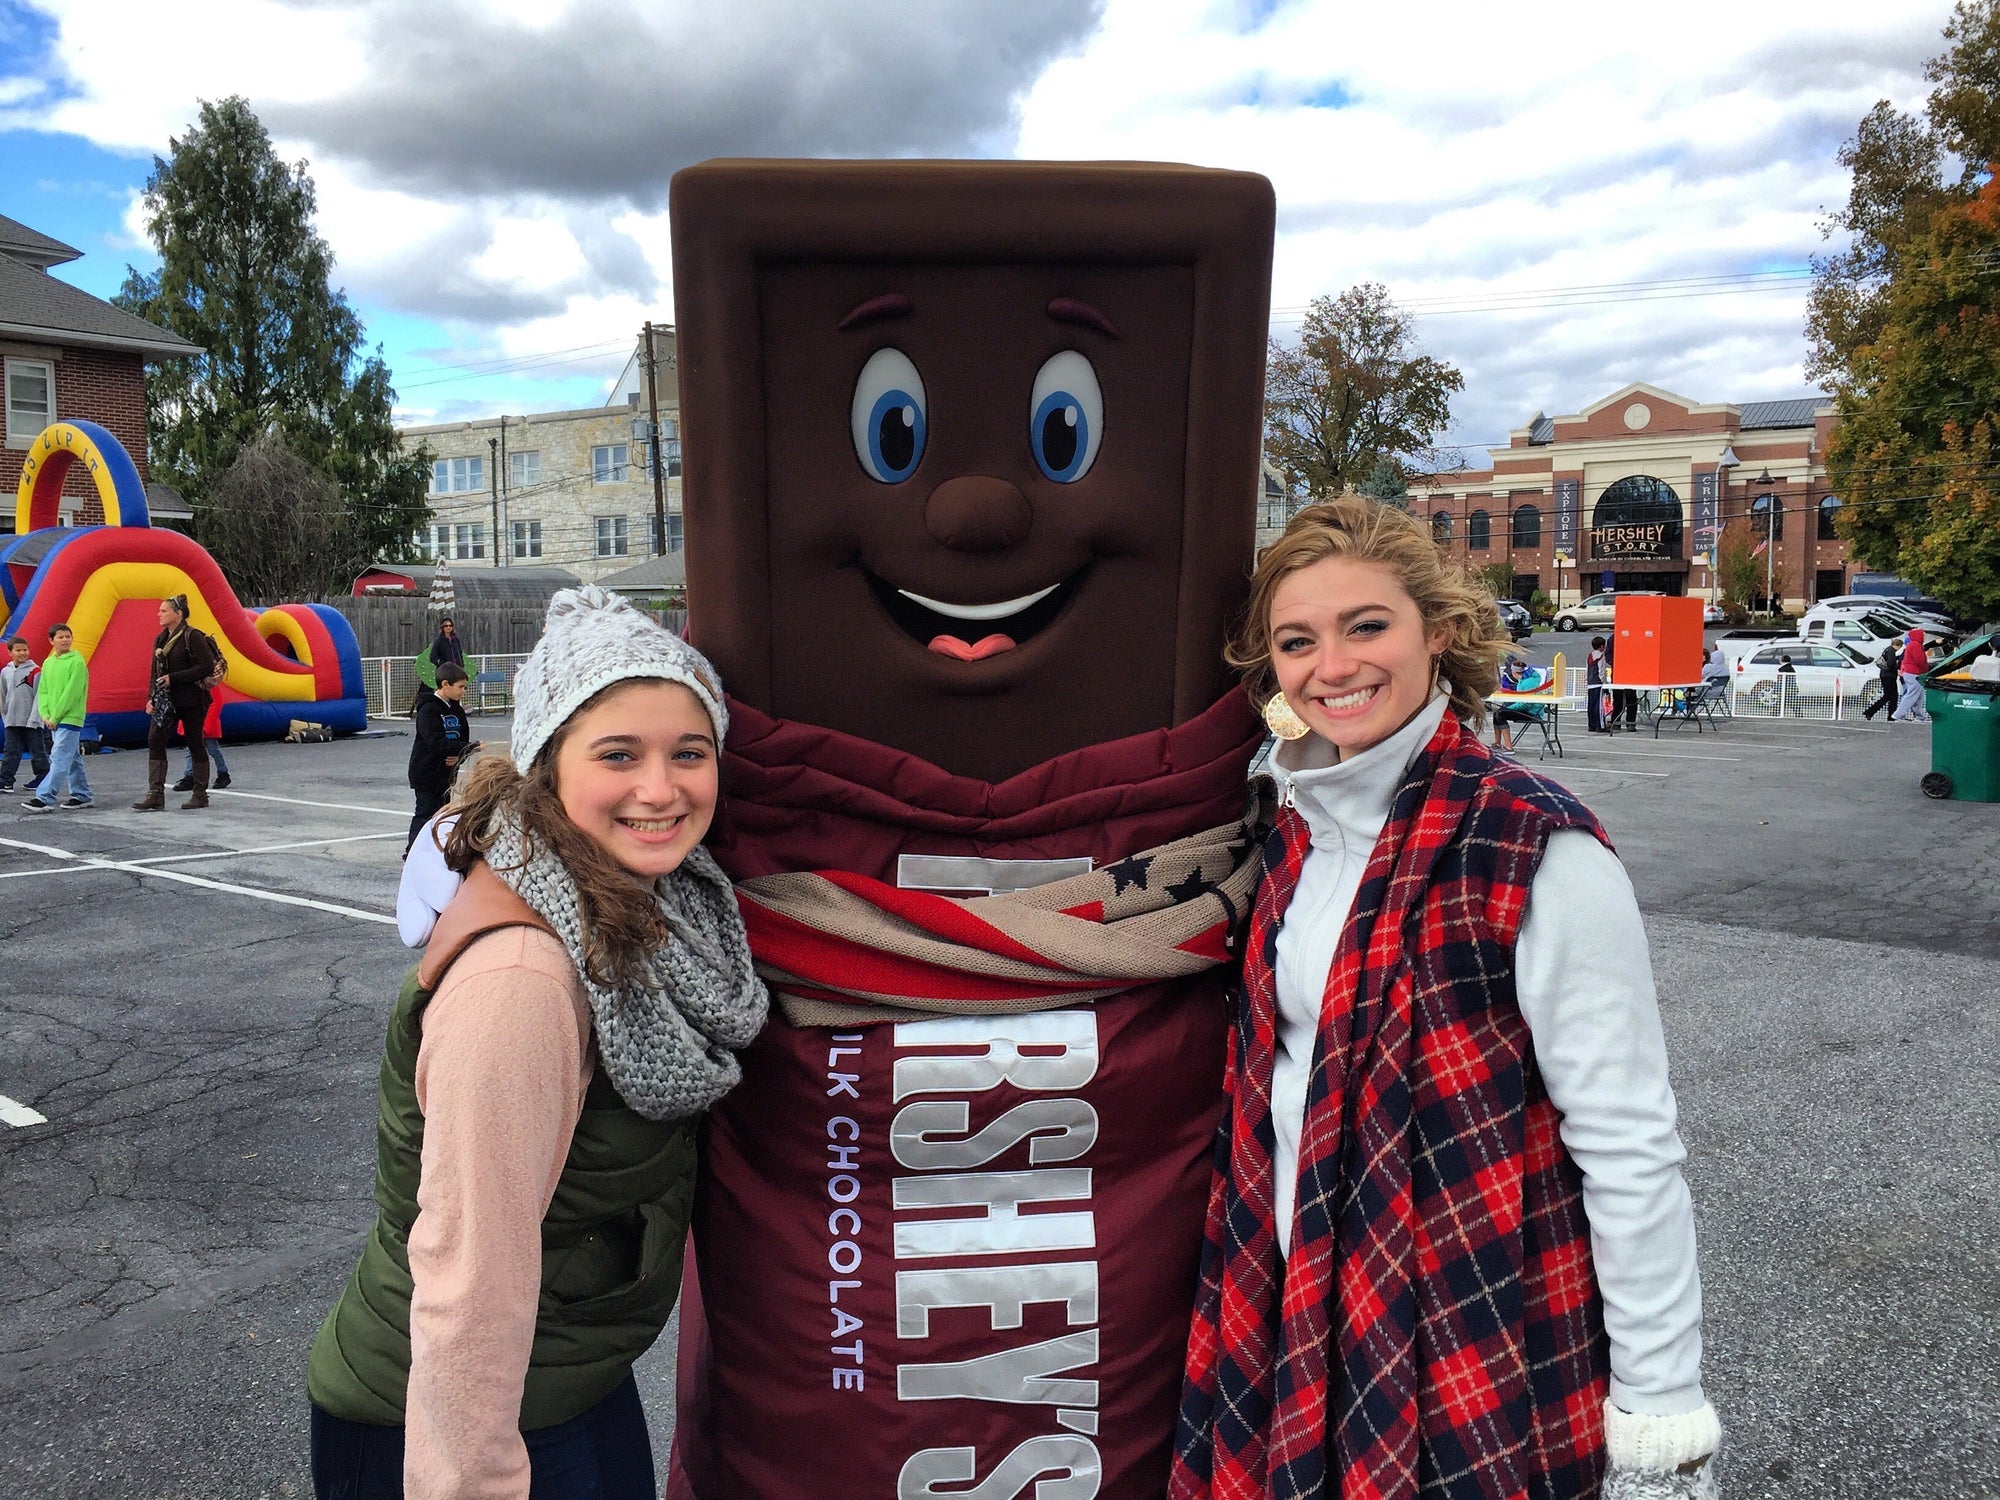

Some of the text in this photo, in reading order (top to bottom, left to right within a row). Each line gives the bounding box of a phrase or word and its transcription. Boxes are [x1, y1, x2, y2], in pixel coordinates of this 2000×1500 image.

[41, 429, 73, 450] ZIP
[83, 447, 98, 472] IT
[1561, 483, 1570, 540] EXPLORE
[1589, 524, 1665, 544] HERSHEY
[1603, 542, 1658, 553] STORY
[890, 854, 1102, 1499] RSHEY'S
[827, 1033, 865, 1393] ILK CHOCOLATE
